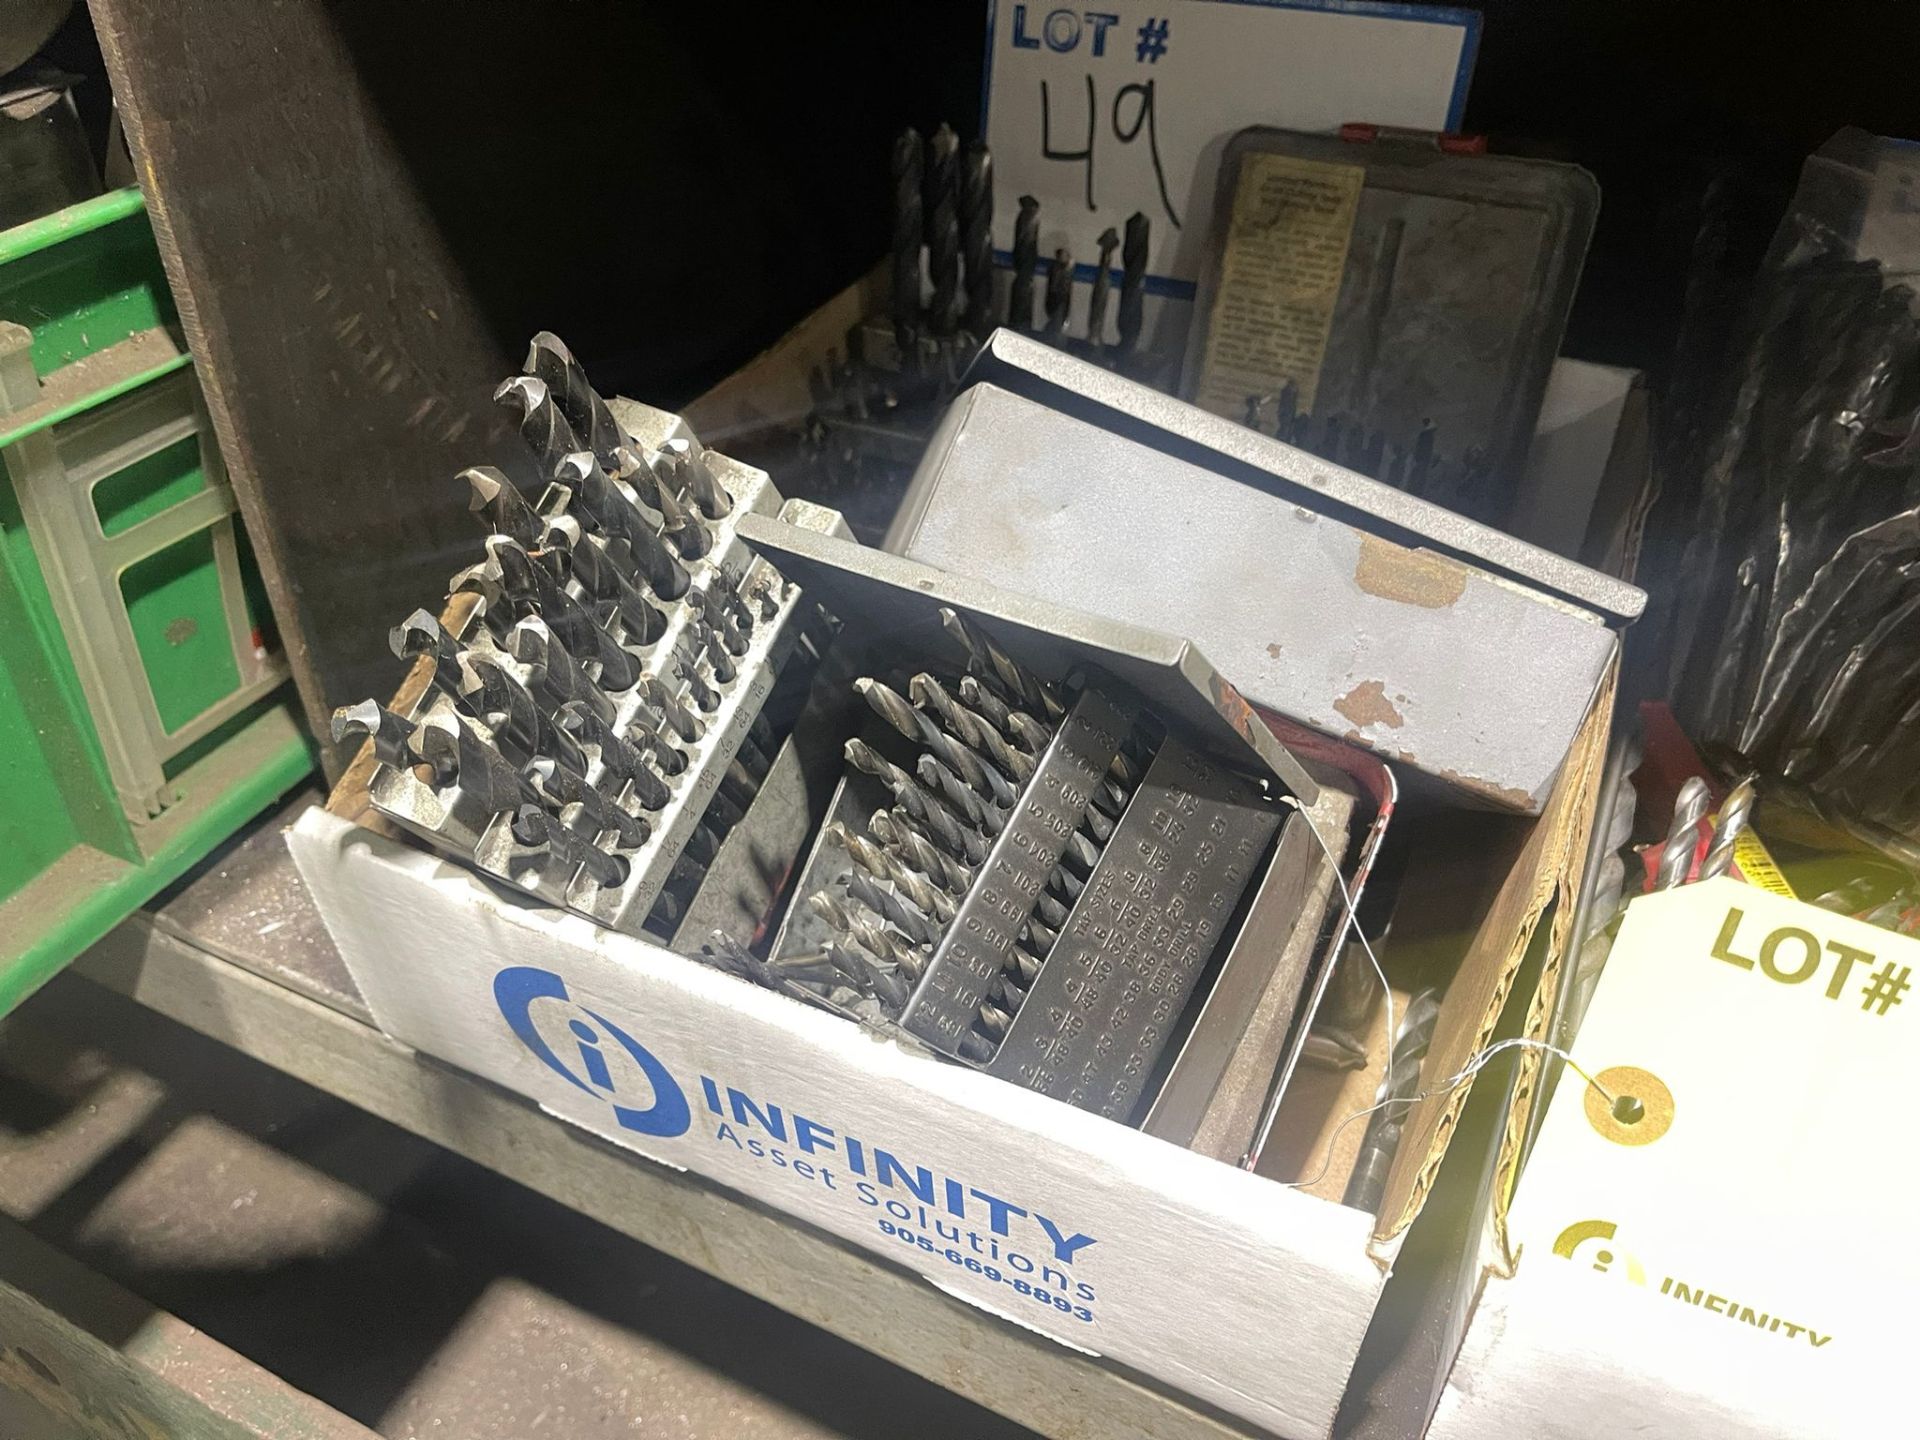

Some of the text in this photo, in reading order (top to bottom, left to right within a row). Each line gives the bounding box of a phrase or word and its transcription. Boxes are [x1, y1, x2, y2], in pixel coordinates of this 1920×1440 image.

[1013, 5, 1169, 63] LOT #
[1041, 73, 1182, 230] 49
[1710, 906, 1912, 1017] LOT#
[700, 1075, 1098, 1265] INFINITY
[716, 1123, 1096, 1302] Asset Solutions
[878, 1219, 1093, 1322] 905-669-8893
